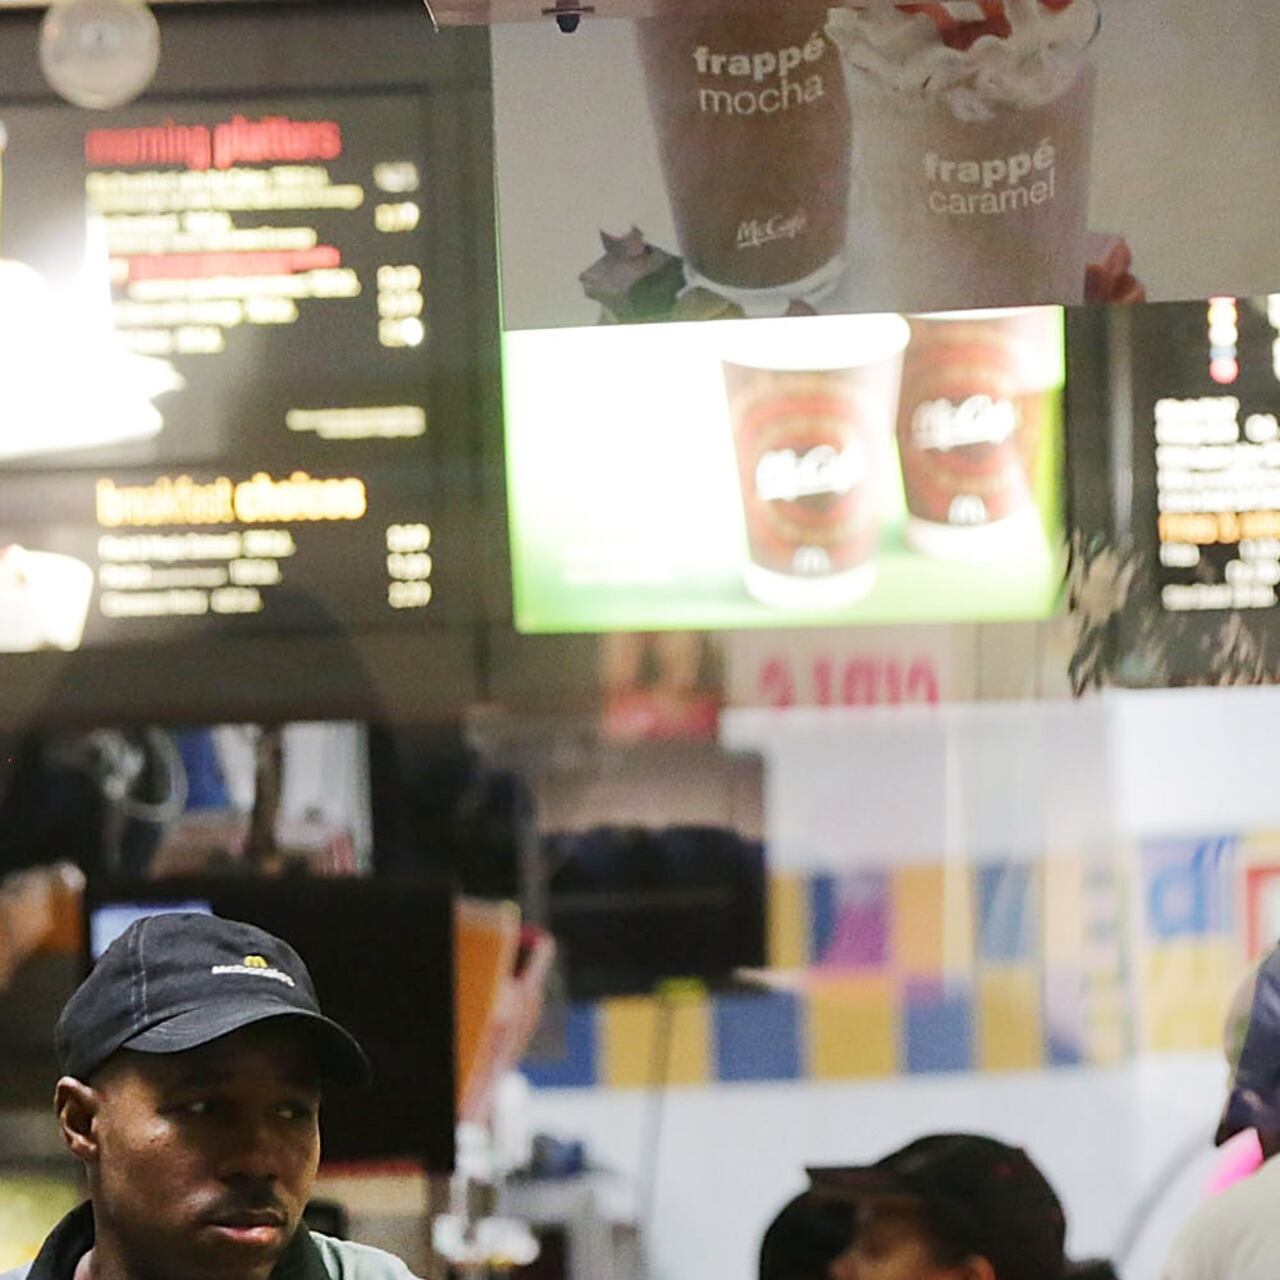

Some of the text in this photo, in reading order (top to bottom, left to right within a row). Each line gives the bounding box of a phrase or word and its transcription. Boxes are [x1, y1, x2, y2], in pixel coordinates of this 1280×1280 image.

[693, 31, 825, 80] frappé
[700, 75, 824, 115] mocha
[923, 136, 1056, 189] frappé
[928, 167, 1056, 214] caramel
